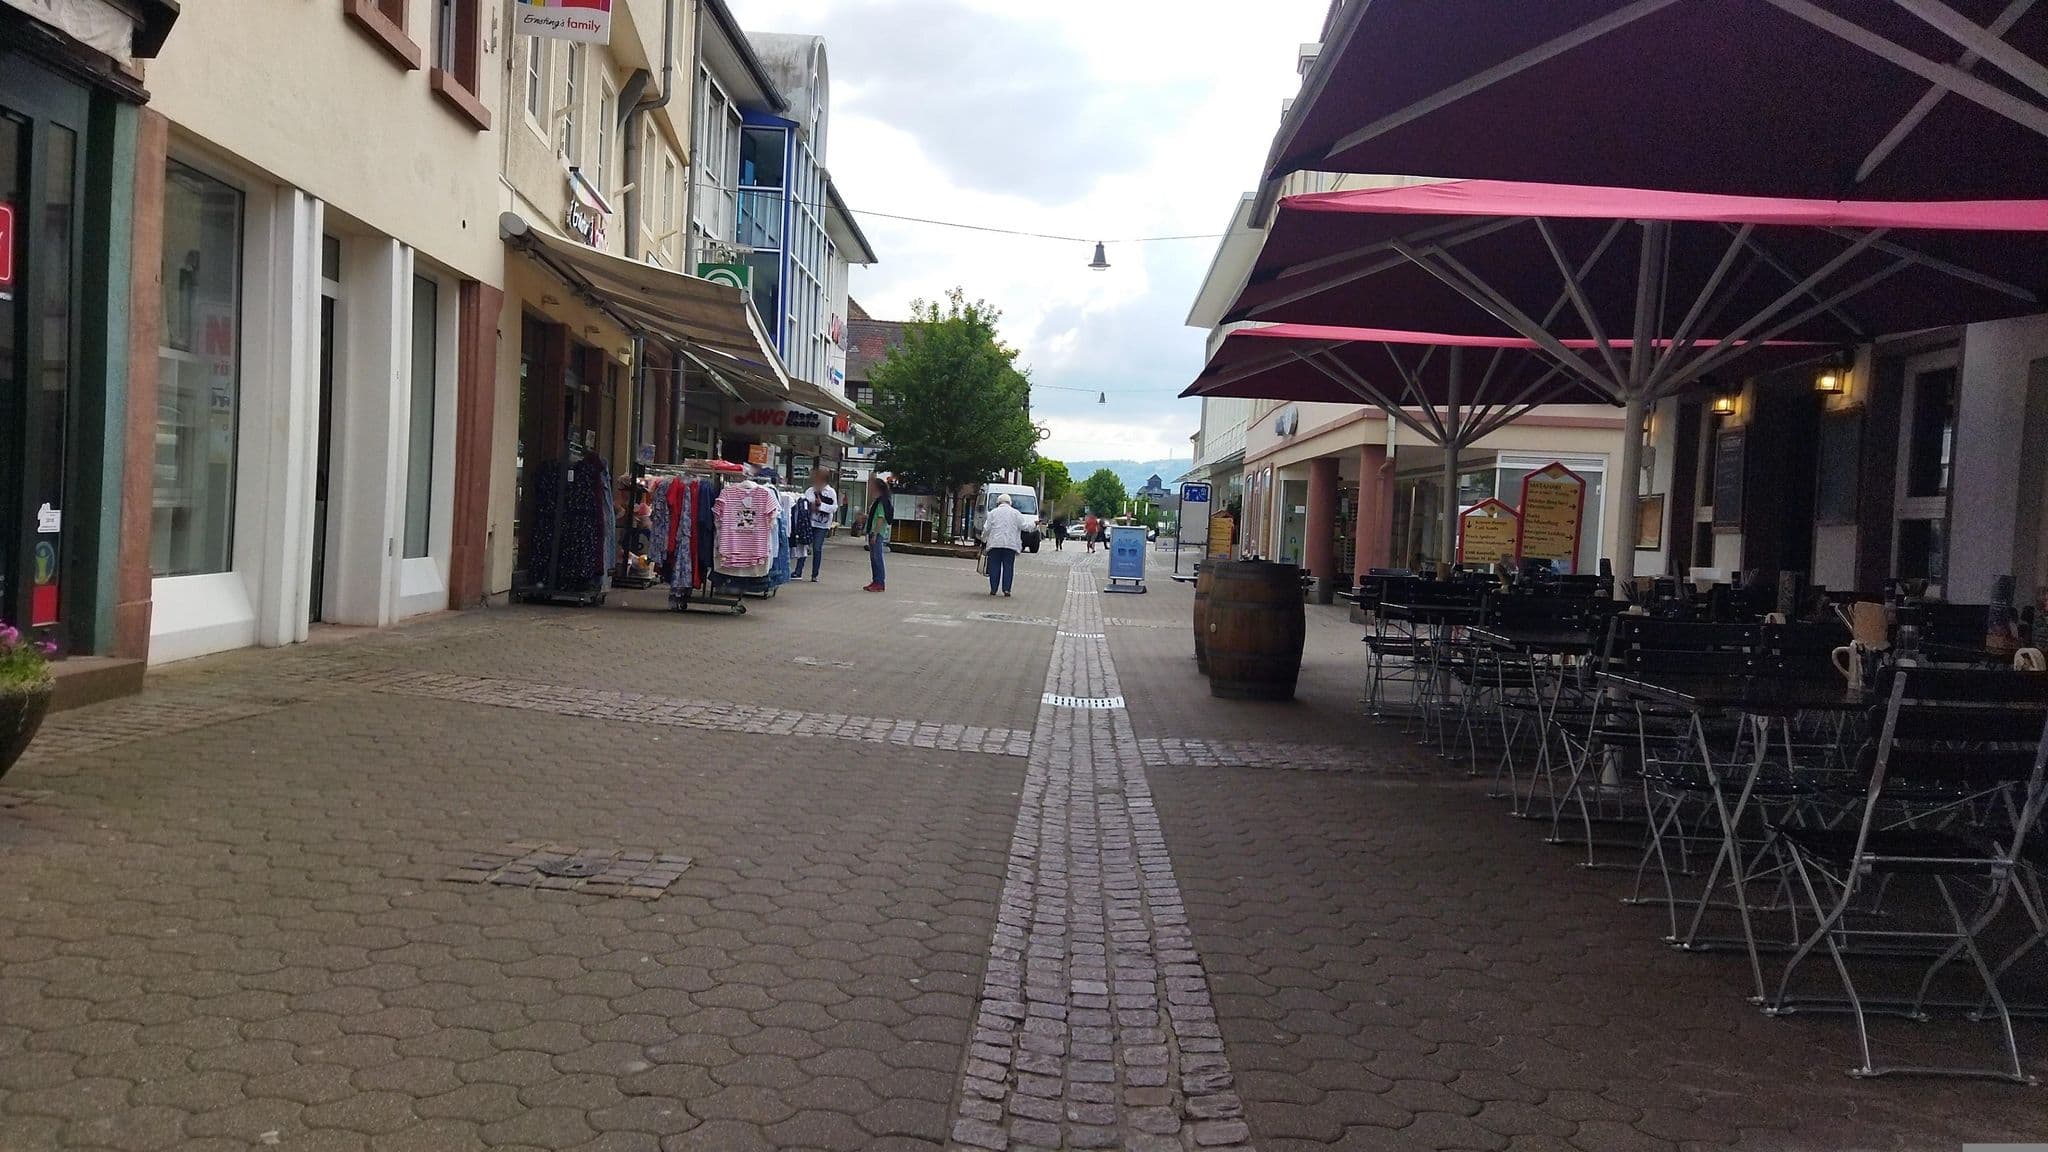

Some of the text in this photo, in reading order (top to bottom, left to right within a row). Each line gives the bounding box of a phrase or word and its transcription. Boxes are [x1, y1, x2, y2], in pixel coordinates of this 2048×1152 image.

[523, 14, 601, 33] Ernsting's family
[734, 407, 786, 426] AWG
